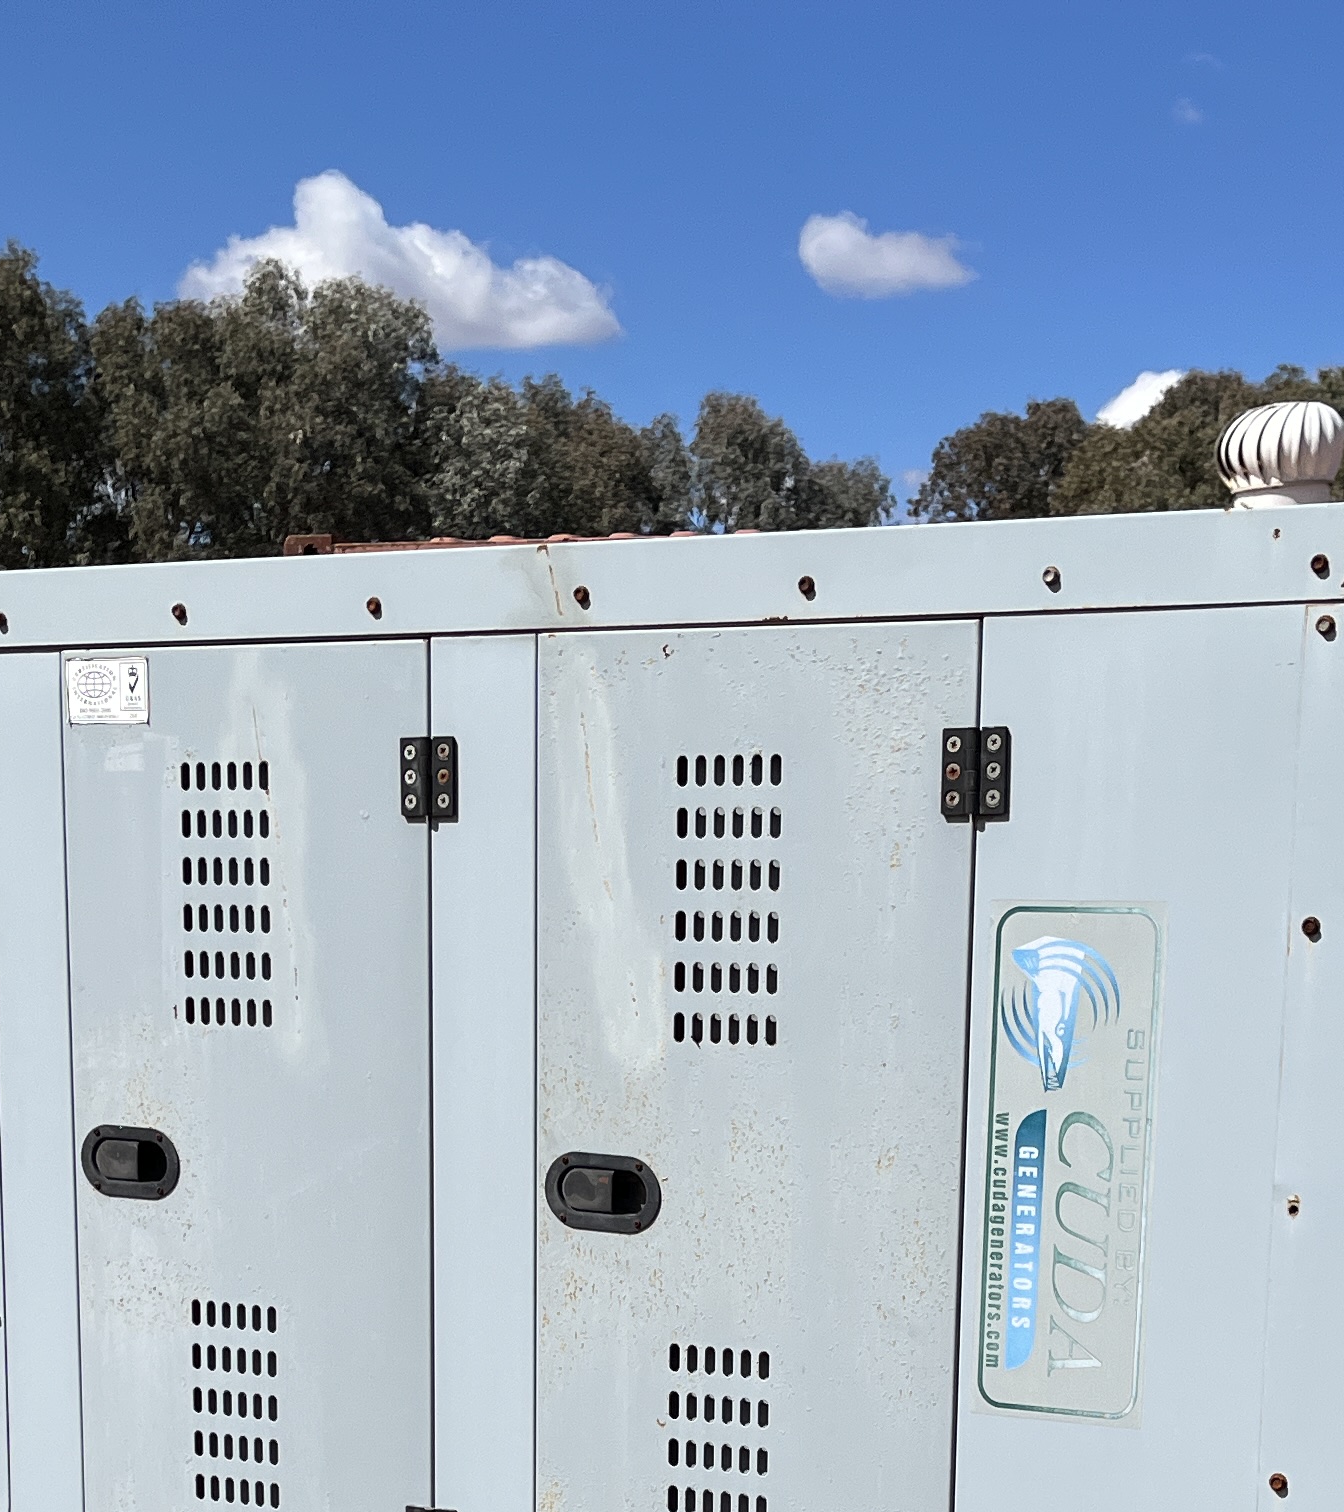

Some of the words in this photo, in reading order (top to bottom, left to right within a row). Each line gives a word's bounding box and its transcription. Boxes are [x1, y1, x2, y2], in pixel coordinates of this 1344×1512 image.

[986, 1111, 1010, 1369] www.cudagenerators.com
[1011, 1146, 1039, 1329] GENERATORS
[1047, 1111, 1114, 1378] CUDA
[1117, 1028, 1146, 1232] SUPPLIED
